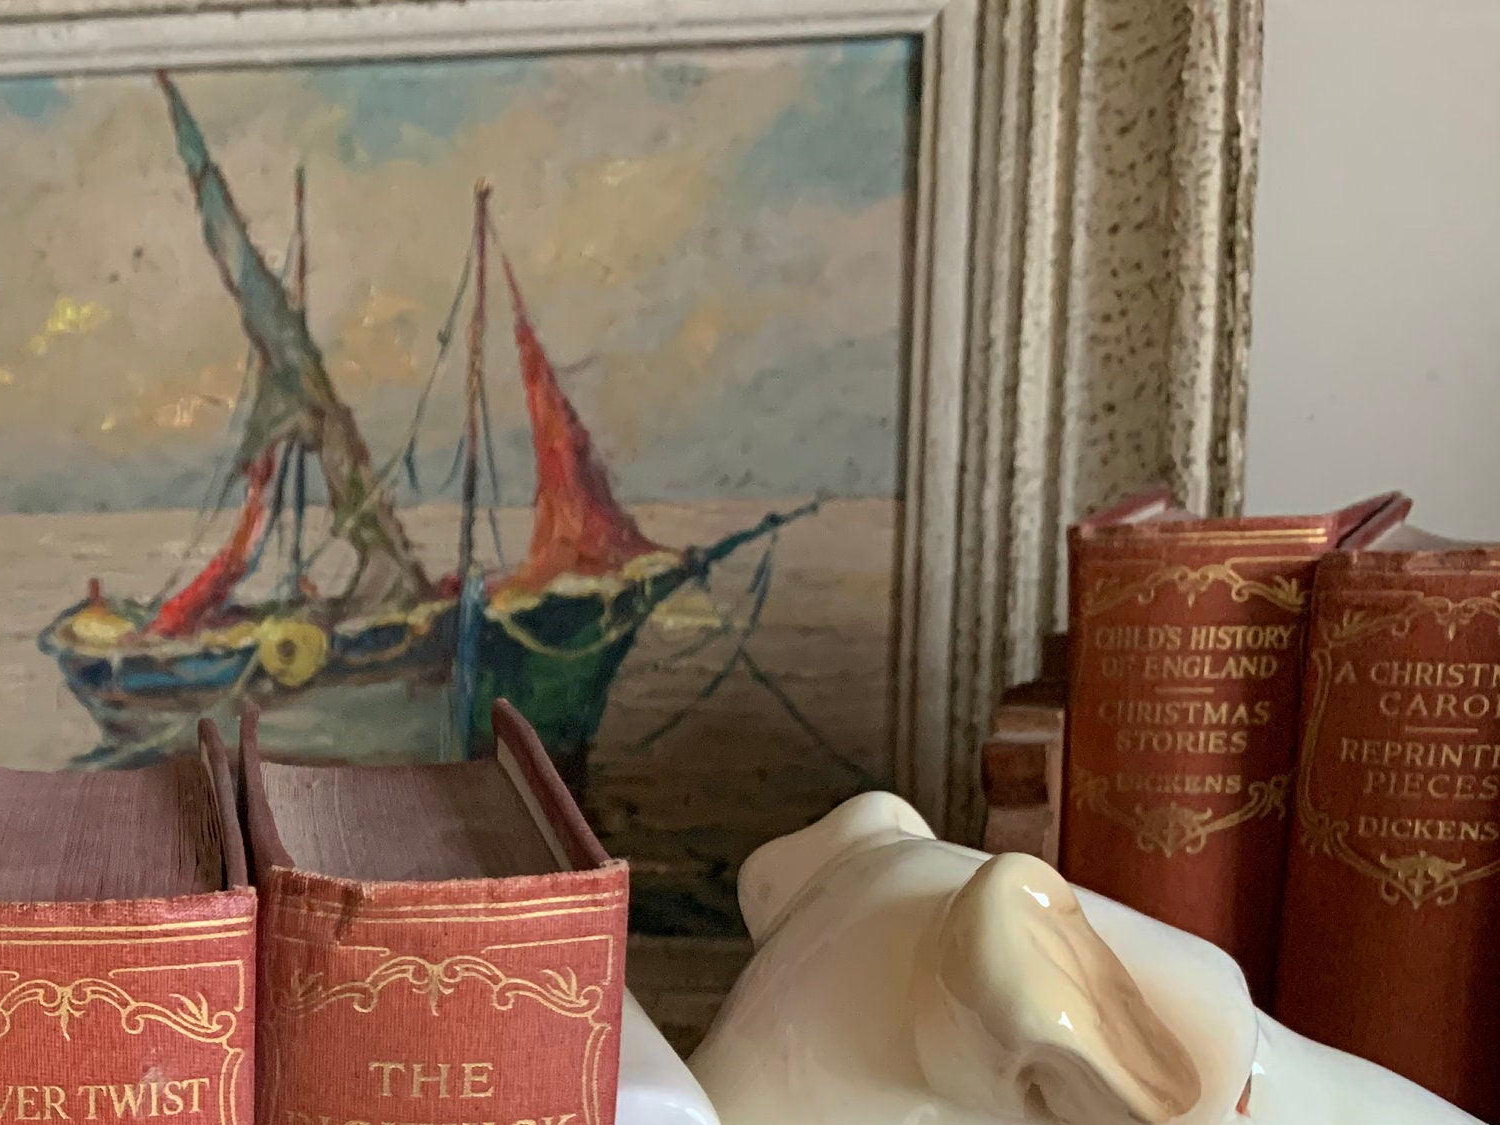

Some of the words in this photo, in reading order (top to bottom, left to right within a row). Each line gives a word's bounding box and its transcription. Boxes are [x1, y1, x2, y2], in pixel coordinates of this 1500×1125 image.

[1190, 624, 1296, 650] HISTORY
[1102, 655, 1135, 679] OF
[1143, 655, 1278, 680] ENGLAND
[1335, 661, 1357, 684] A
[1100, 700, 1271, 725] CHRISTMAS
[1379, 691, 1500, 719] CARO
[1116, 729, 1248, 753] STORIES
[1362, 770, 1499, 800] PIECES
[1358, 815, 1499, 841] DICKENS
[368, 1061, 494, 1098] THE
[78, 1077, 210, 1121] TWIST
